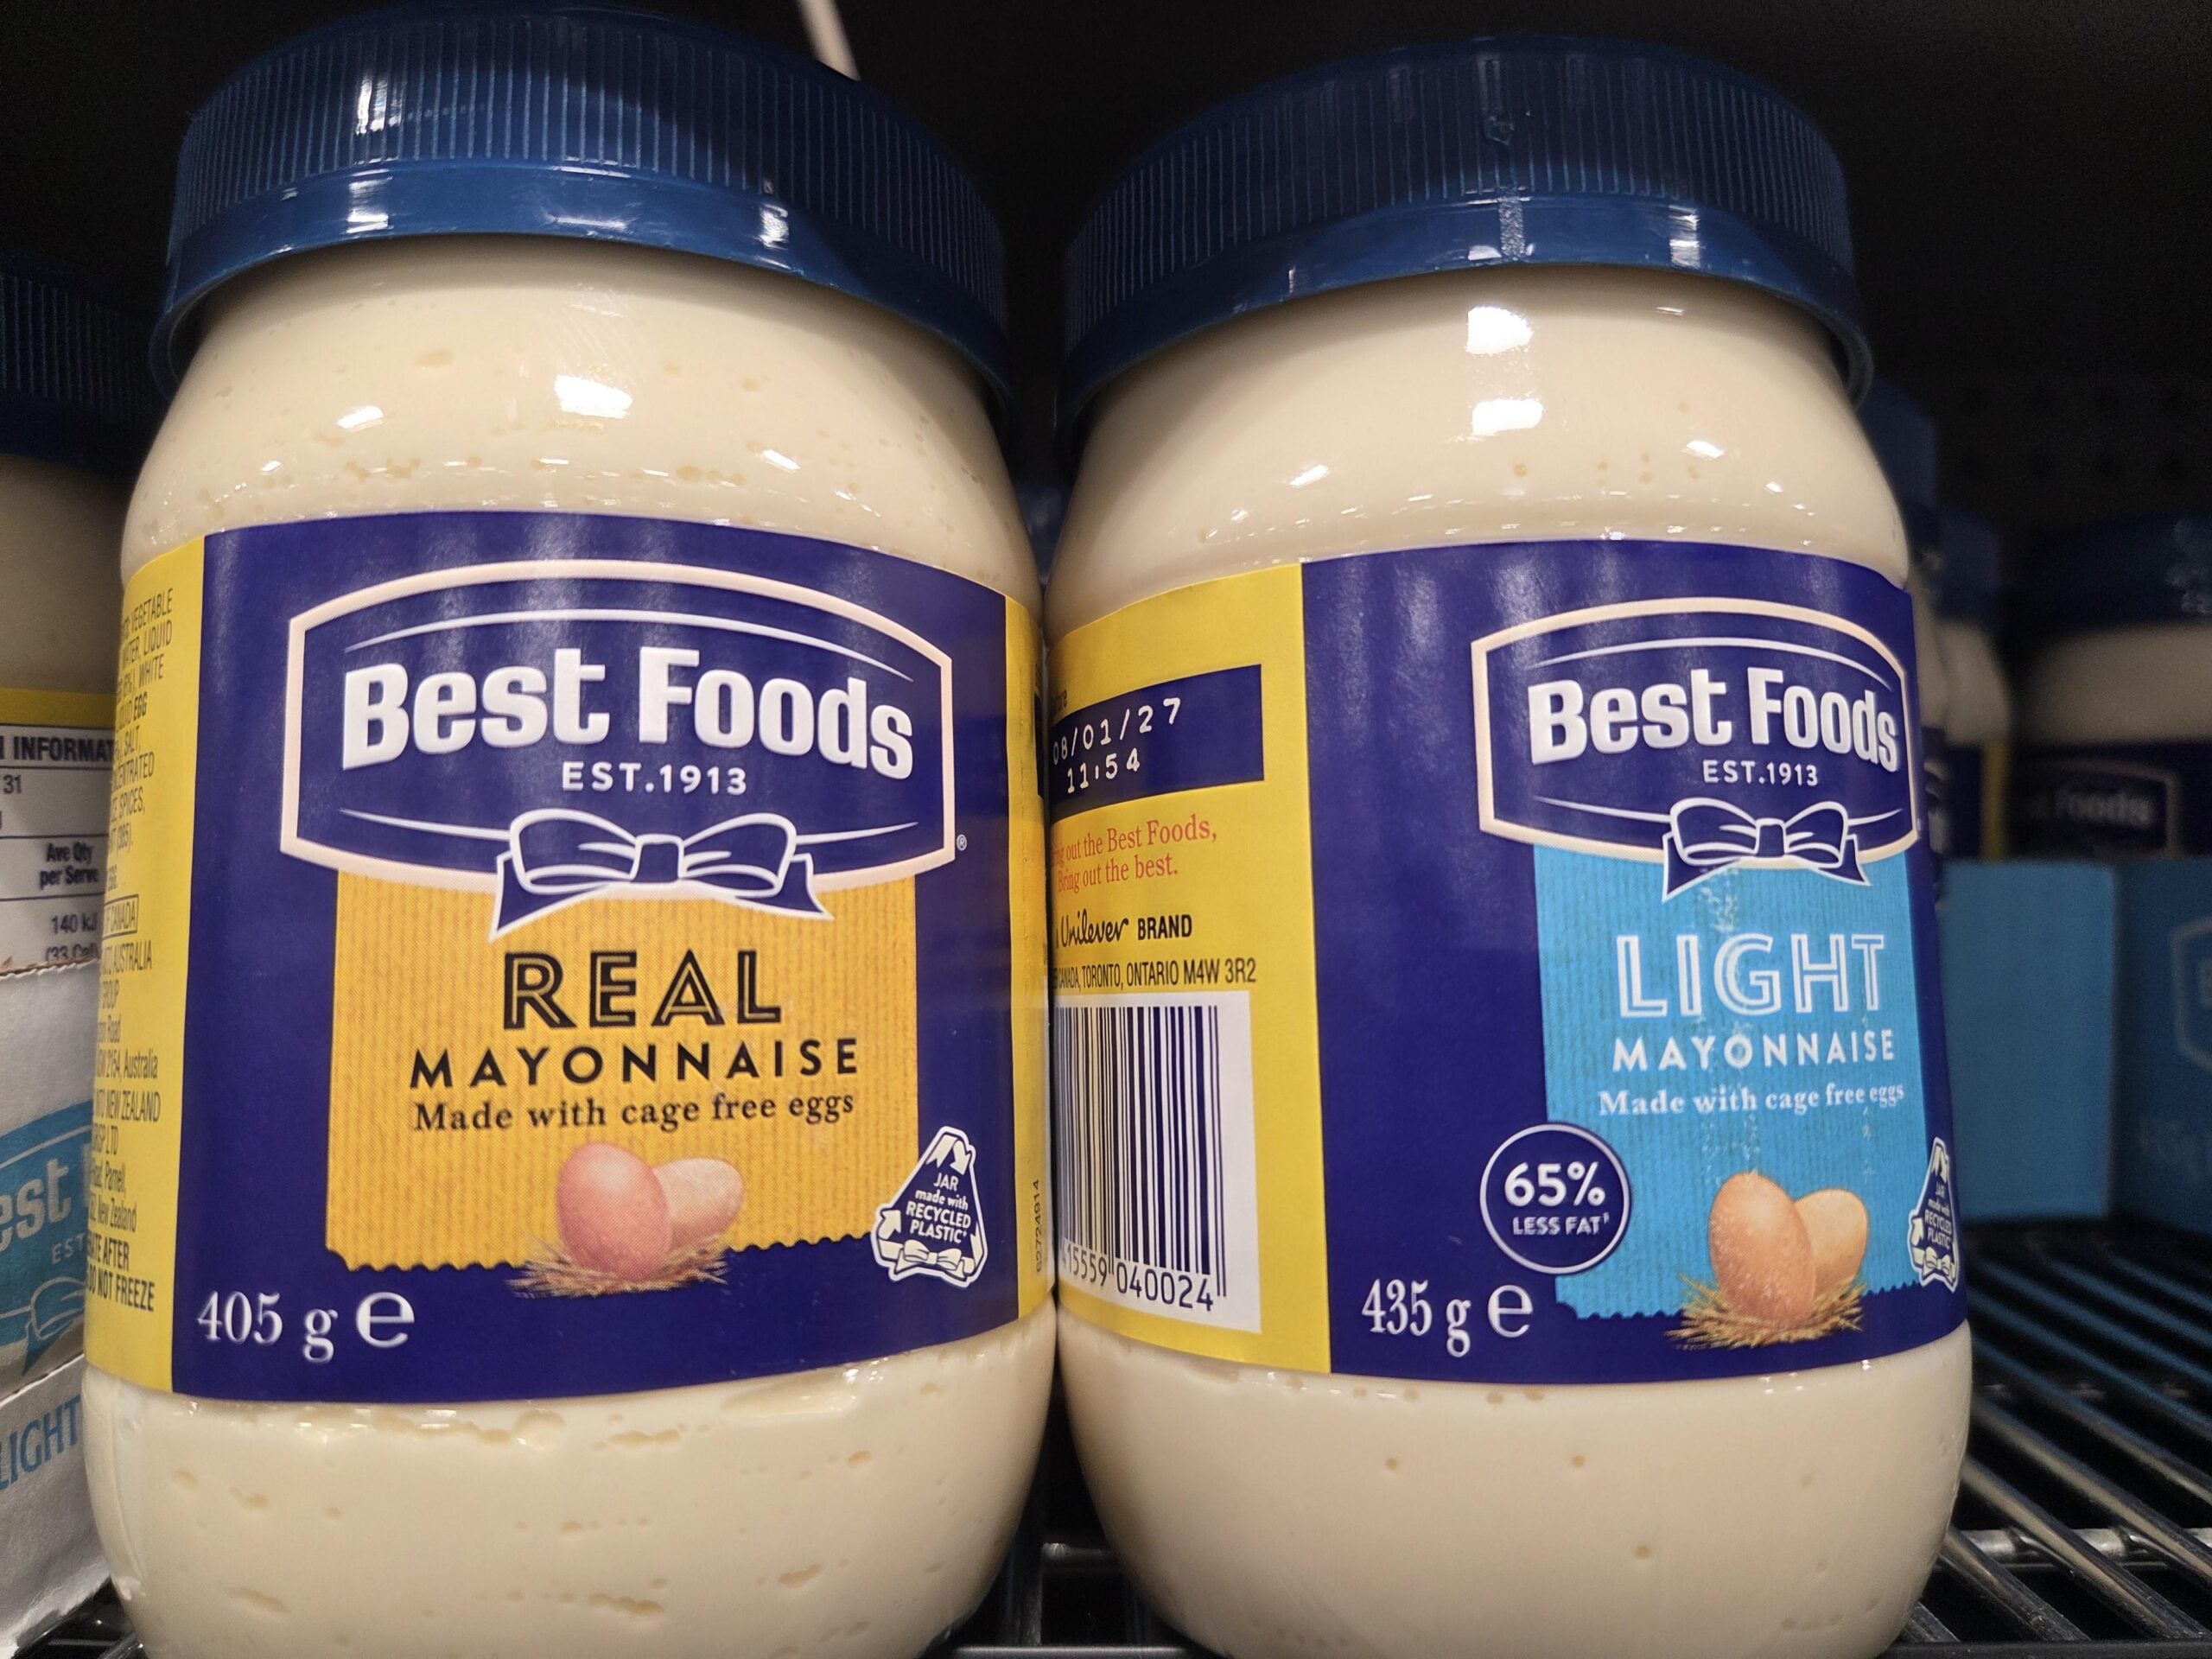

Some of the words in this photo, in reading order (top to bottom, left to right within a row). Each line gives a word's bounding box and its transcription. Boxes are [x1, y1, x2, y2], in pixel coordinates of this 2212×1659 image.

[131, 588, 173, 633] VEGETABLE
[143, 620, 173, 657] LIQUID
[138, 653, 164, 688] WHITE
[133, 691, 148, 721] EGG
[342, 647, 610, 770] Best
[639, 646, 914, 779] Foods
[1528, 668, 1732, 765] Best
[1747, 666, 1898, 772] Foods
[1052, 697, 1181, 765] 08/01/27
[561, 760, 747, 796] EST.1913
[1702, 759, 1819, 786] EST.1913
[119, 785, 146, 819] SPICES,
[47, 842, 70, 862] Ave
[73, 841, 93, 865] Qty
[1065, 839, 1082, 862] out
[1083, 832, 1103, 858] the
[1107, 825, 1142, 853] Best
[1146, 813, 1217, 845] Foods,
[40, 868, 60, 889] per
[66, 865, 99, 885] Serve
[1058, 867, 1080, 894] Bring
[1083, 864, 1102, 887] out
[1105, 858, 1129, 882] the
[1134, 852, 1179, 879] best.
[51, 914, 77, 934] 140
[110, 899, 136, 931] CANADA
[1061, 908, 1129, 947] Unilever
[1137, 914, 1192, 940] BRAND
[114, 940, 152, 973] AUSTRALIA
[1082, 963, 1123, 990] TORONTO,
[1126, 960, 1179, 987] ONTARIO
[1184, 958, 1220, 985] M4W
[1224, 957, 1257, 983] 3R2
[504, 948, 781, 1030] REAL
[1616, 932, 1885, 1018] LIGHT
[124, 1048, 158, 1079] Australia
[409, 1038, 858, 1089] MAYONNAISE
[1612, 1029, 1895, 1072] MAYONNAISE
[105, 1089, 121, 1120] NEW
[121, 1090, 162, 1122] ZEALAND
[414, 1101, 513, 1132] Made
[528, 1098, 605, 1128] with
[621, 1100, 700, 1132] cage
[711, 1092, 777, 1120] free
[789, 1092, 855, 1124] eggs
[1598, 1089, 1685, 1116] Made
[1693, 1084, 1758, 1113] with
[1764, 1085, 1819, 1116] cage
[1825, 1083, 1866, 1105] free
[1869, 1082, 1905, 1107] eggs
[933, 1172, 959, 1192] JAR
[1504, 1161, 1605, 1207] 65%
[110, 1198, 137, 1233] Zealand
[906, 1200, 971, 1229] RECYCLED
[915, 1189, 945, 1205] made
[947, 1194, 969, 1211] with
[1512, 1217, 1560, 1235] LESS
[103, 1236, 130, 1271] AFTER
[98, 1268, 113, 1300] NOT
[115, 1274, 155, 1313] FREEZE
[1116, 1262, 1214, 1312] 040024
[196, 1290, 283, 1344] 405
[304, 1308, 339, 1363] g
[1361, 1278, 1433, 1336] 435
[1446, 1298, 1471, 1357] g
